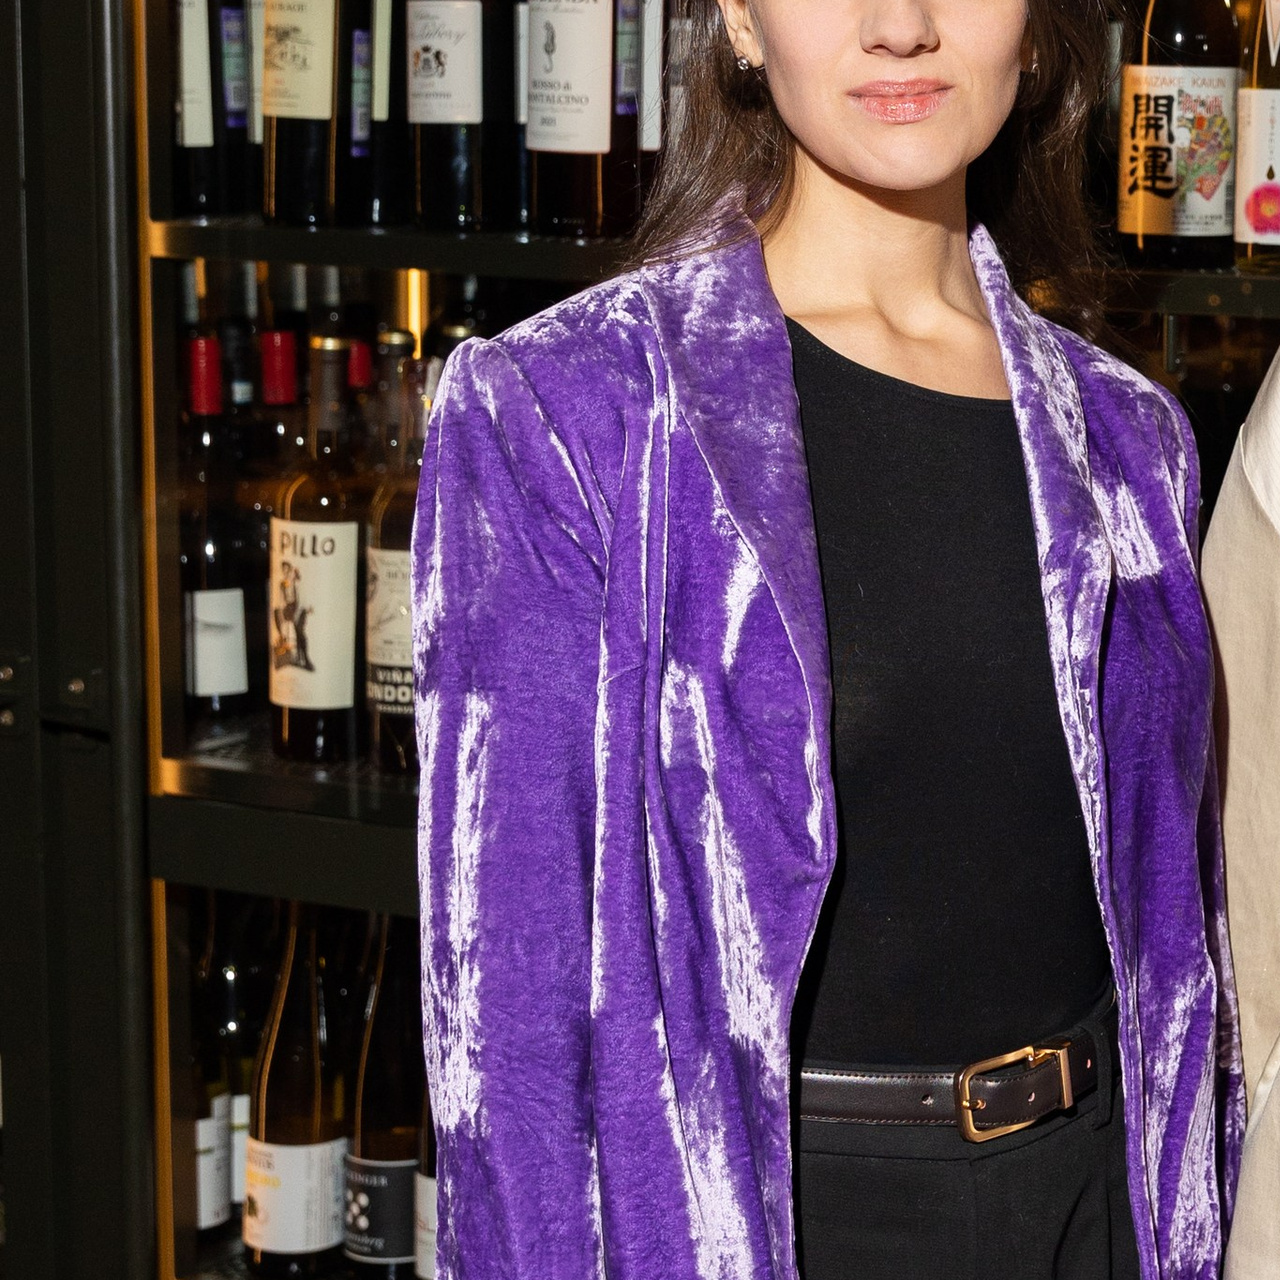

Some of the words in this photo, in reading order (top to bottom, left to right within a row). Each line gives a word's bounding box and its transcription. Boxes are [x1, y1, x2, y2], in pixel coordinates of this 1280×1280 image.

[529, 93, 589, 106] ONTALCINO
[1127, 93, 1180, 200] 開運
[279, 531, 337, 559] PILLO
